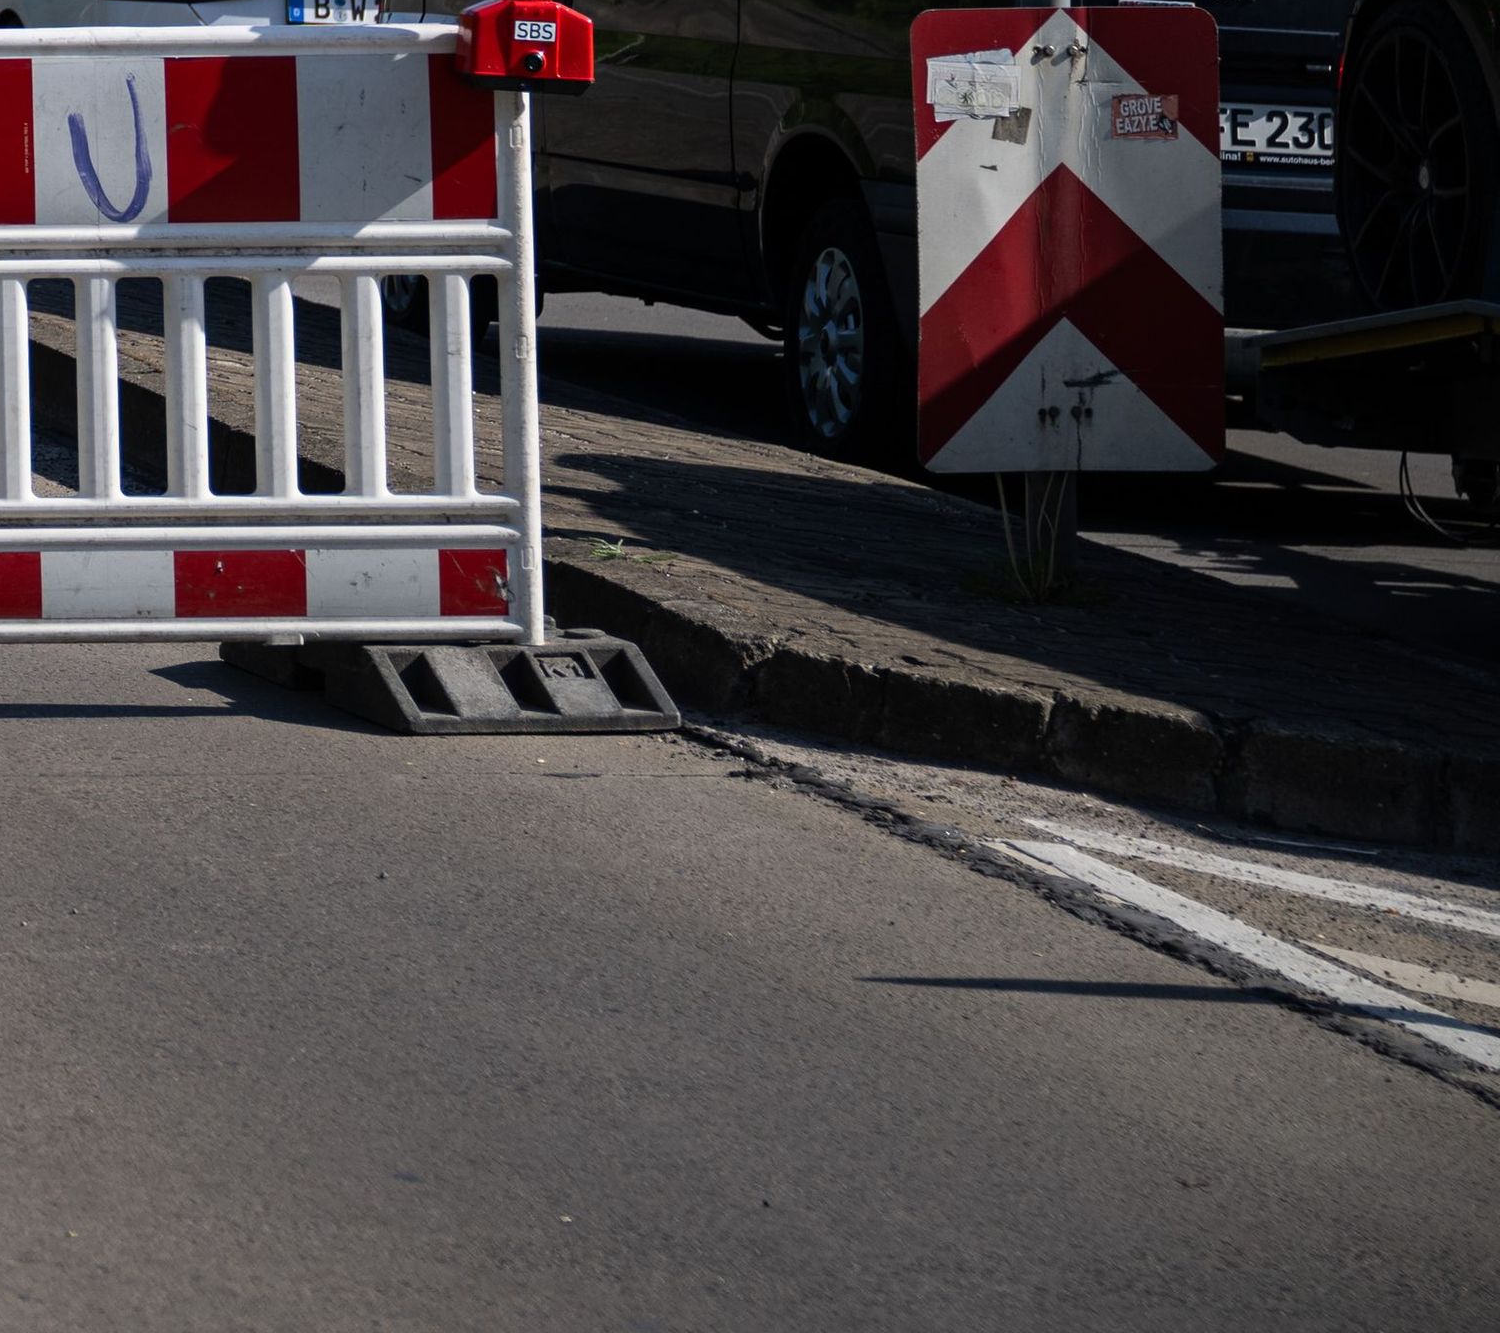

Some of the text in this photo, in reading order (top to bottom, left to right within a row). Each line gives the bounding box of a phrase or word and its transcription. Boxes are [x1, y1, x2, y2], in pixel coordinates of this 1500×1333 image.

[517, 23, 553, 40] SBS
[1121, 97, 1163, 116] GROVE
[1219, 151, 1241, 162] ina!
